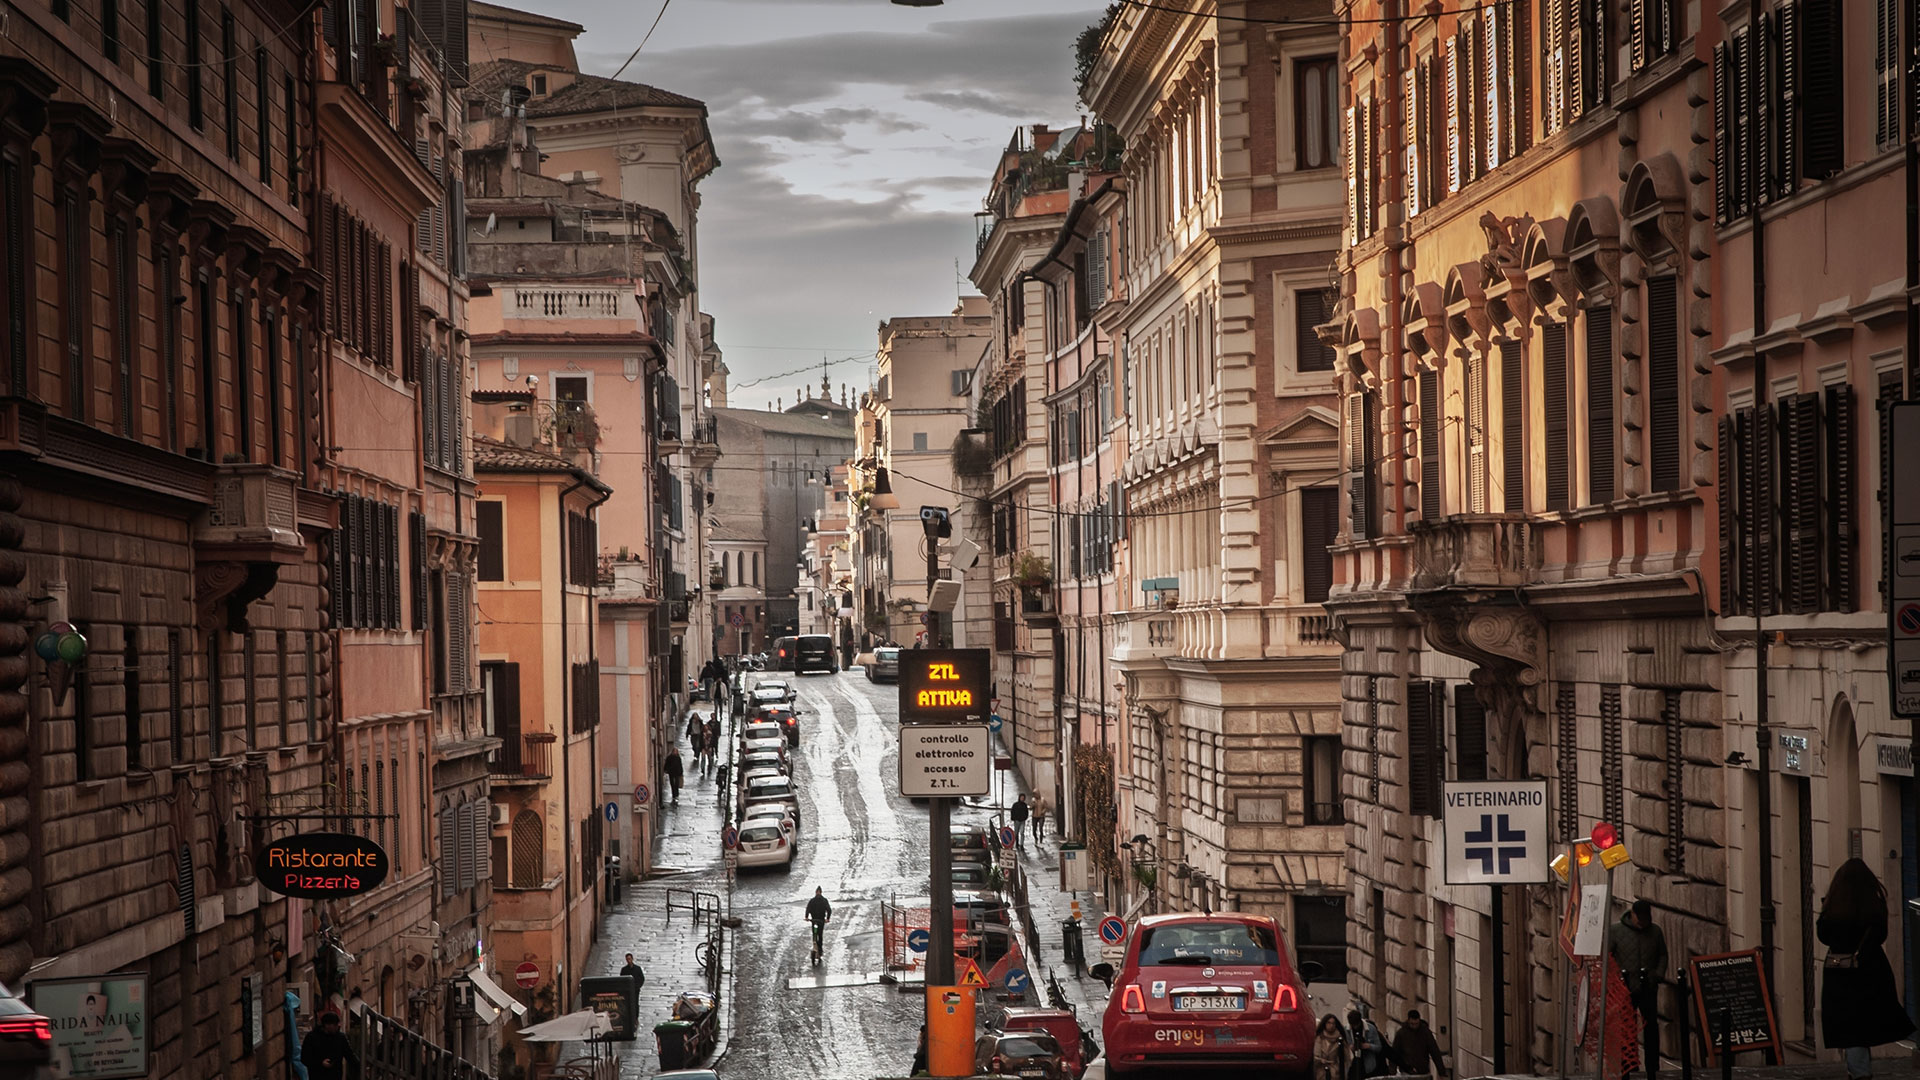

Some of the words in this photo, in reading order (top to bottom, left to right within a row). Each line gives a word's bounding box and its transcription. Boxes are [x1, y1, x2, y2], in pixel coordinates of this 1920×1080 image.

[928, 664, 960, 680] ZTL
[917, 690, 973, 707] ATTIVA
[920, 735, 969, 743] controllo
[915, 749, 974, 759] elettronico
[923, 765, 966, 773] accesso
[930, 780, 959, 788] Z.T.L.
[1446, 791, 1542, 807] VETERINARIO
[269, 848, 377, 868] Ristorante
[1212, 948, 1243, 958] enjoy
[1699, 960, 1727, 968] KOREAN
[1727, 957, 1753, 965] CUISINE
[455, 981, 471, 1005] T
[1182, 997, 1197, 1008] GP
[1200, 996, 1236, 1008] 513XK
[50, 1017, 88, 1030] RIDA
[95, 1012, 141, 1027] NAILS
[1154, 1029, 1204, 1046] enjoy
